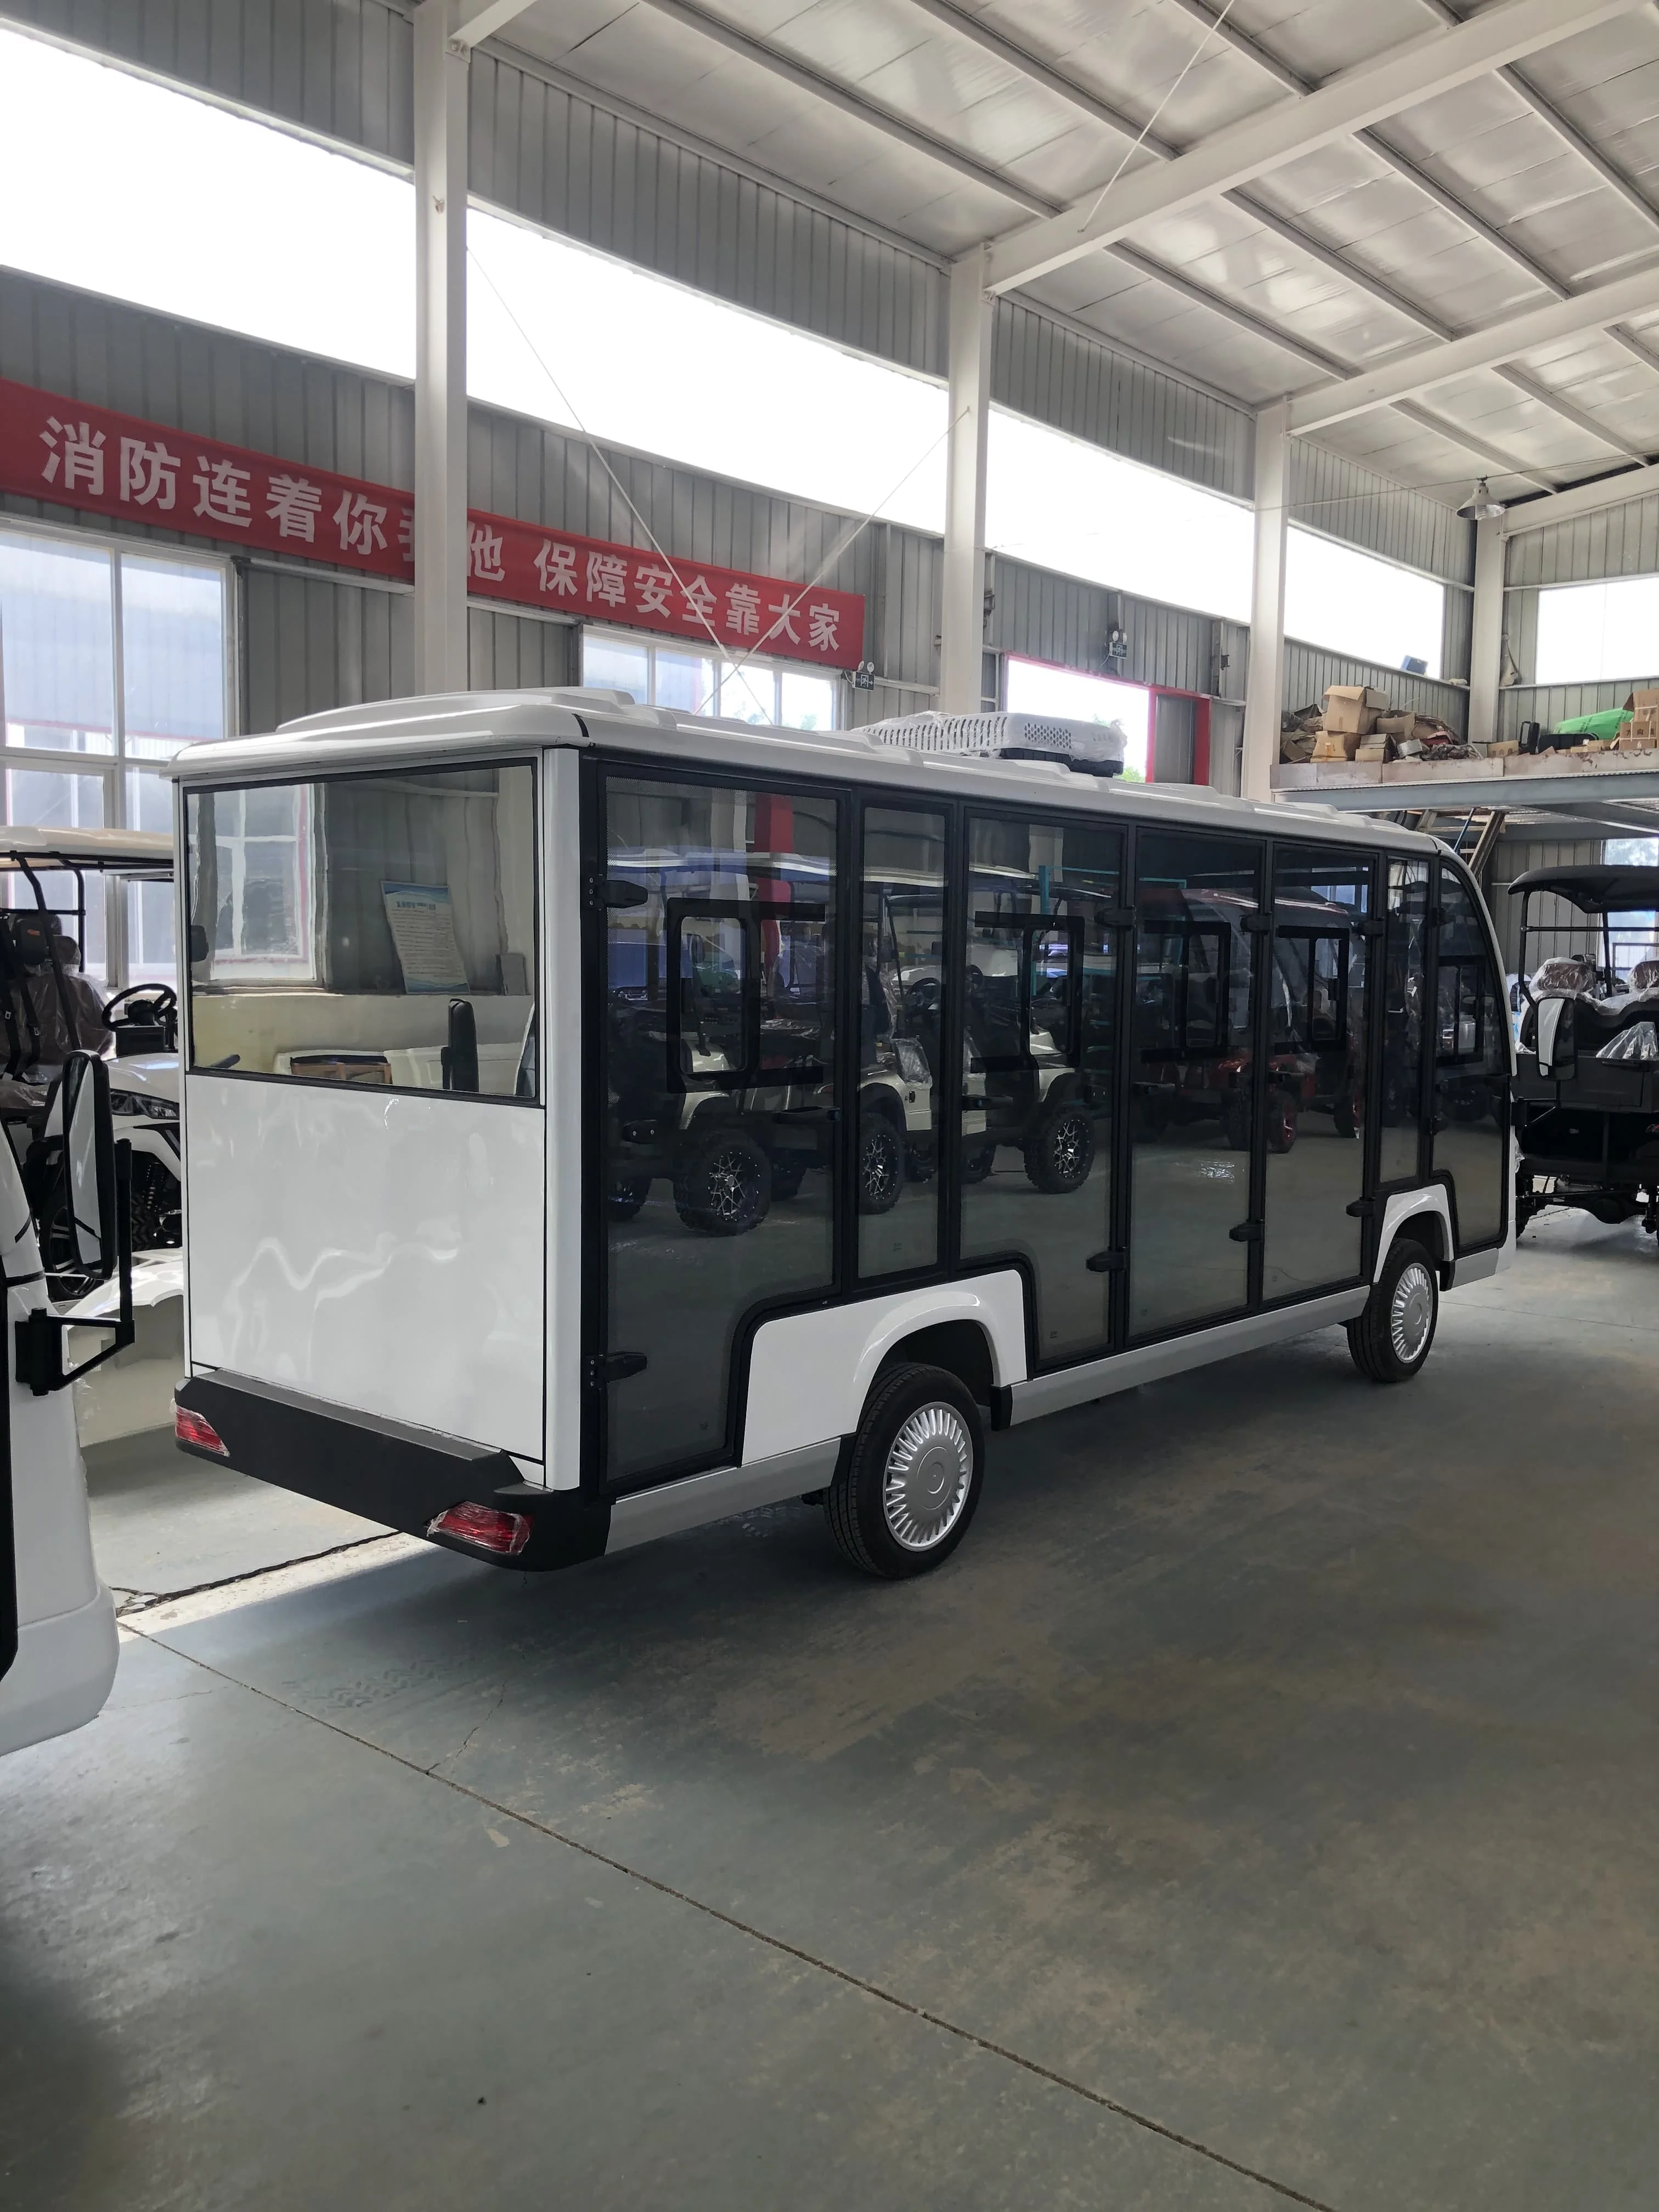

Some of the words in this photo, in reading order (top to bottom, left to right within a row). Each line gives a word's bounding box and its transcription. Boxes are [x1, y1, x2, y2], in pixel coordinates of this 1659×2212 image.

[533, 539, 839, 651] 保障安全靠大家
